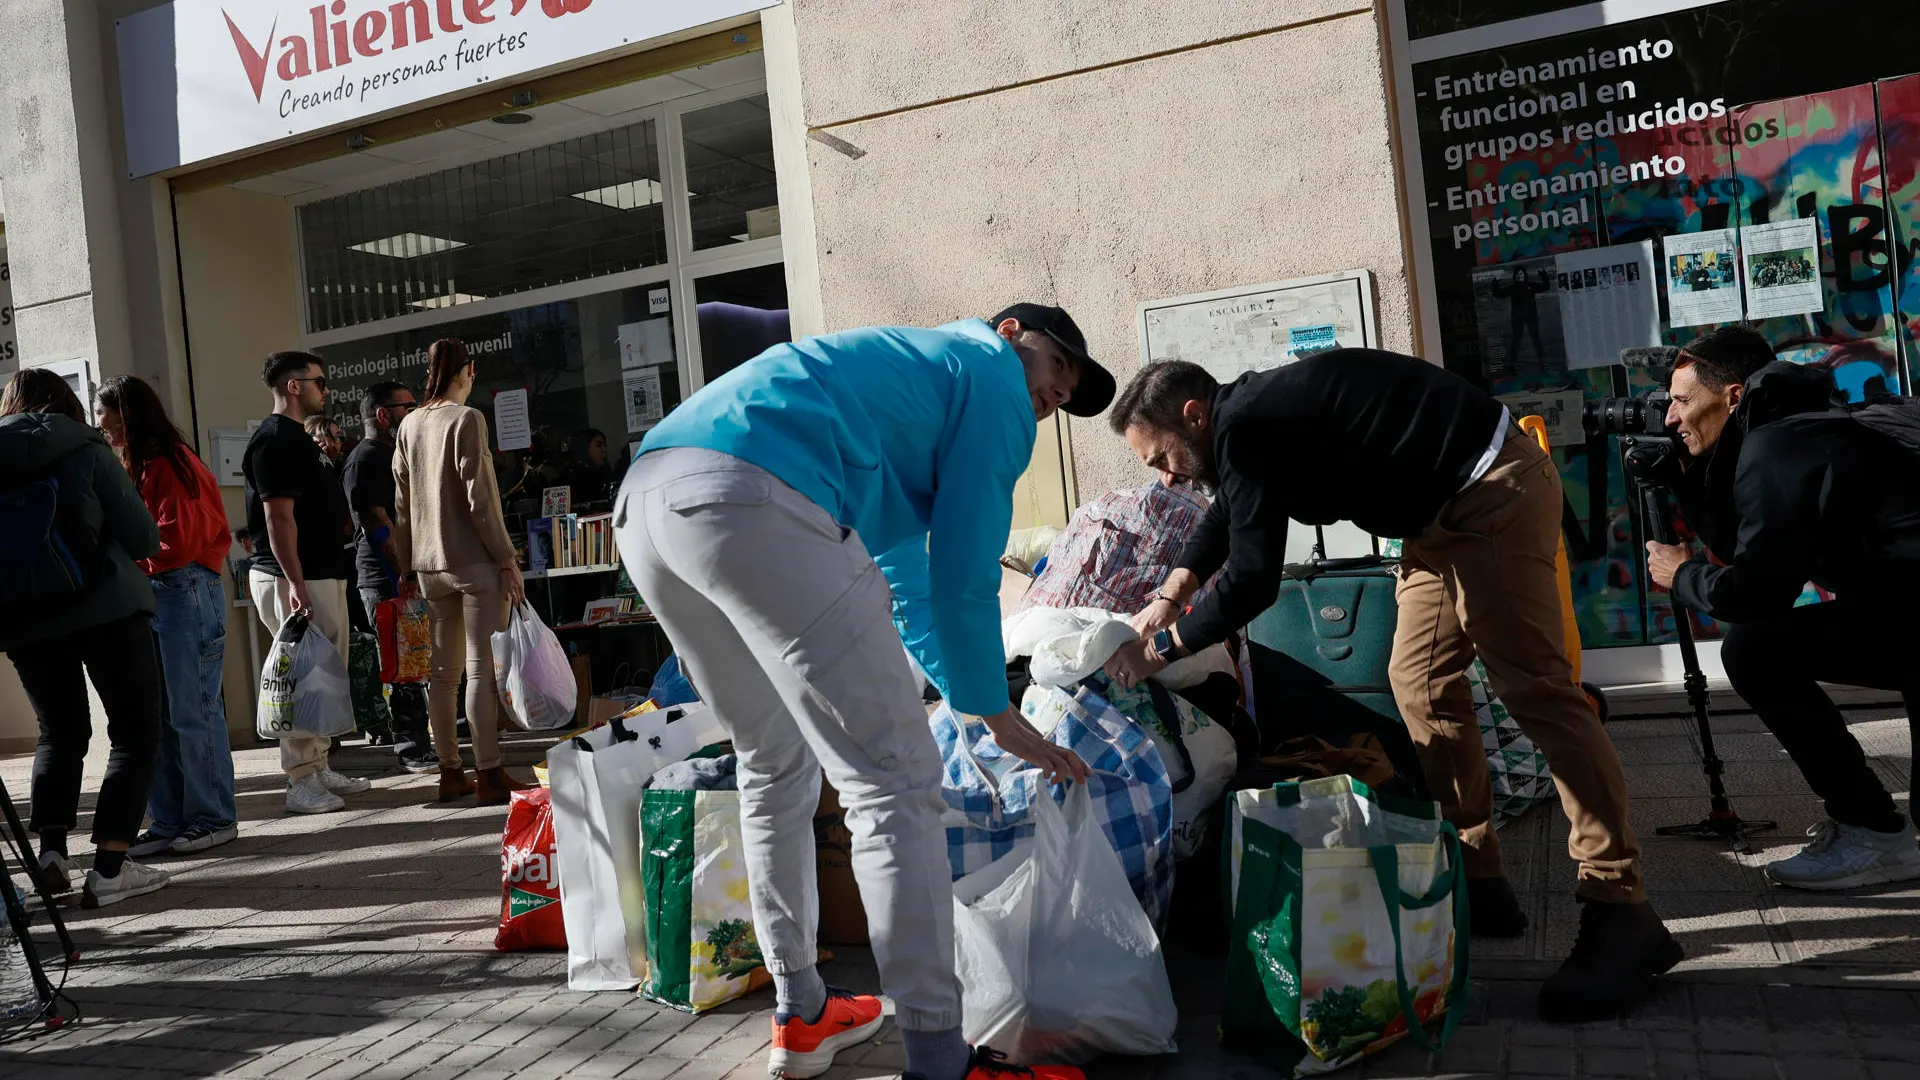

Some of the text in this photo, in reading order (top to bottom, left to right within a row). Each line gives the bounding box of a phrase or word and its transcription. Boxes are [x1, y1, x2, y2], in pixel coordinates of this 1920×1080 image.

[279, 30, 528, 118] Creando personas fuertes
[1434, 38, 1674, 100] Entrenamiento
[1440, 79, 1636, 132] funcional en
[1444, 97, 1727, 170] grupos reducidos
[1446, 154, 1686, 212] Entrenamiento
[1453, 197, 1589, 249] personal
[651, 296, 668, 305] VISA
[1266, 299, 1275, 311] 7
[328, 353, 399, 381] Psicología
[401, 347, 429, 368] infa
